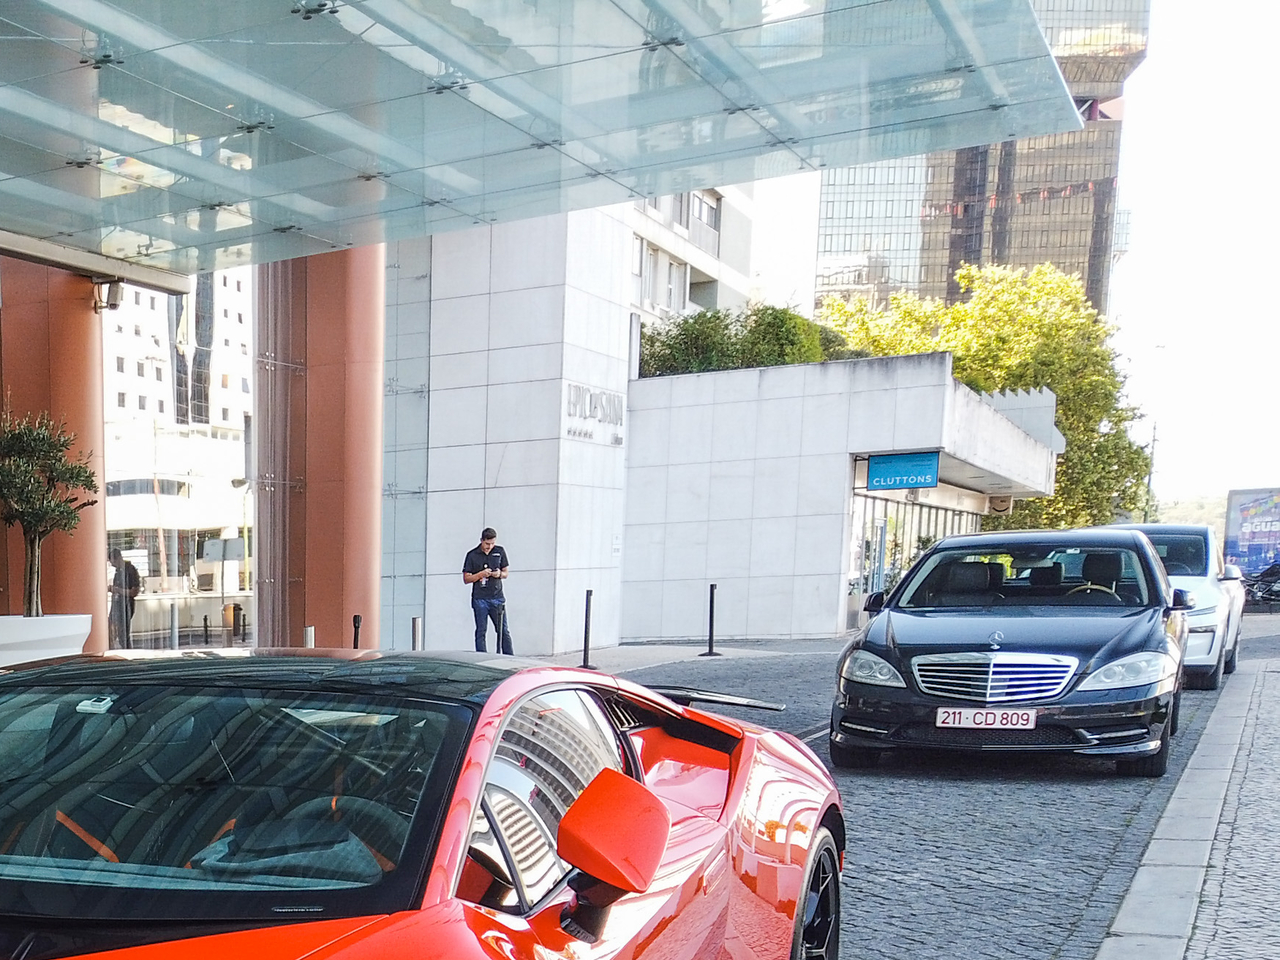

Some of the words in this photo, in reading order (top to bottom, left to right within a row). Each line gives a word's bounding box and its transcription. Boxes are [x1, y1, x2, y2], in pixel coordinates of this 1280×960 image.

[873, 475, 932, 486] CLUTTONS
[973, 712, 997, 726] CD
[1000, 712, 1030, 726] 809
